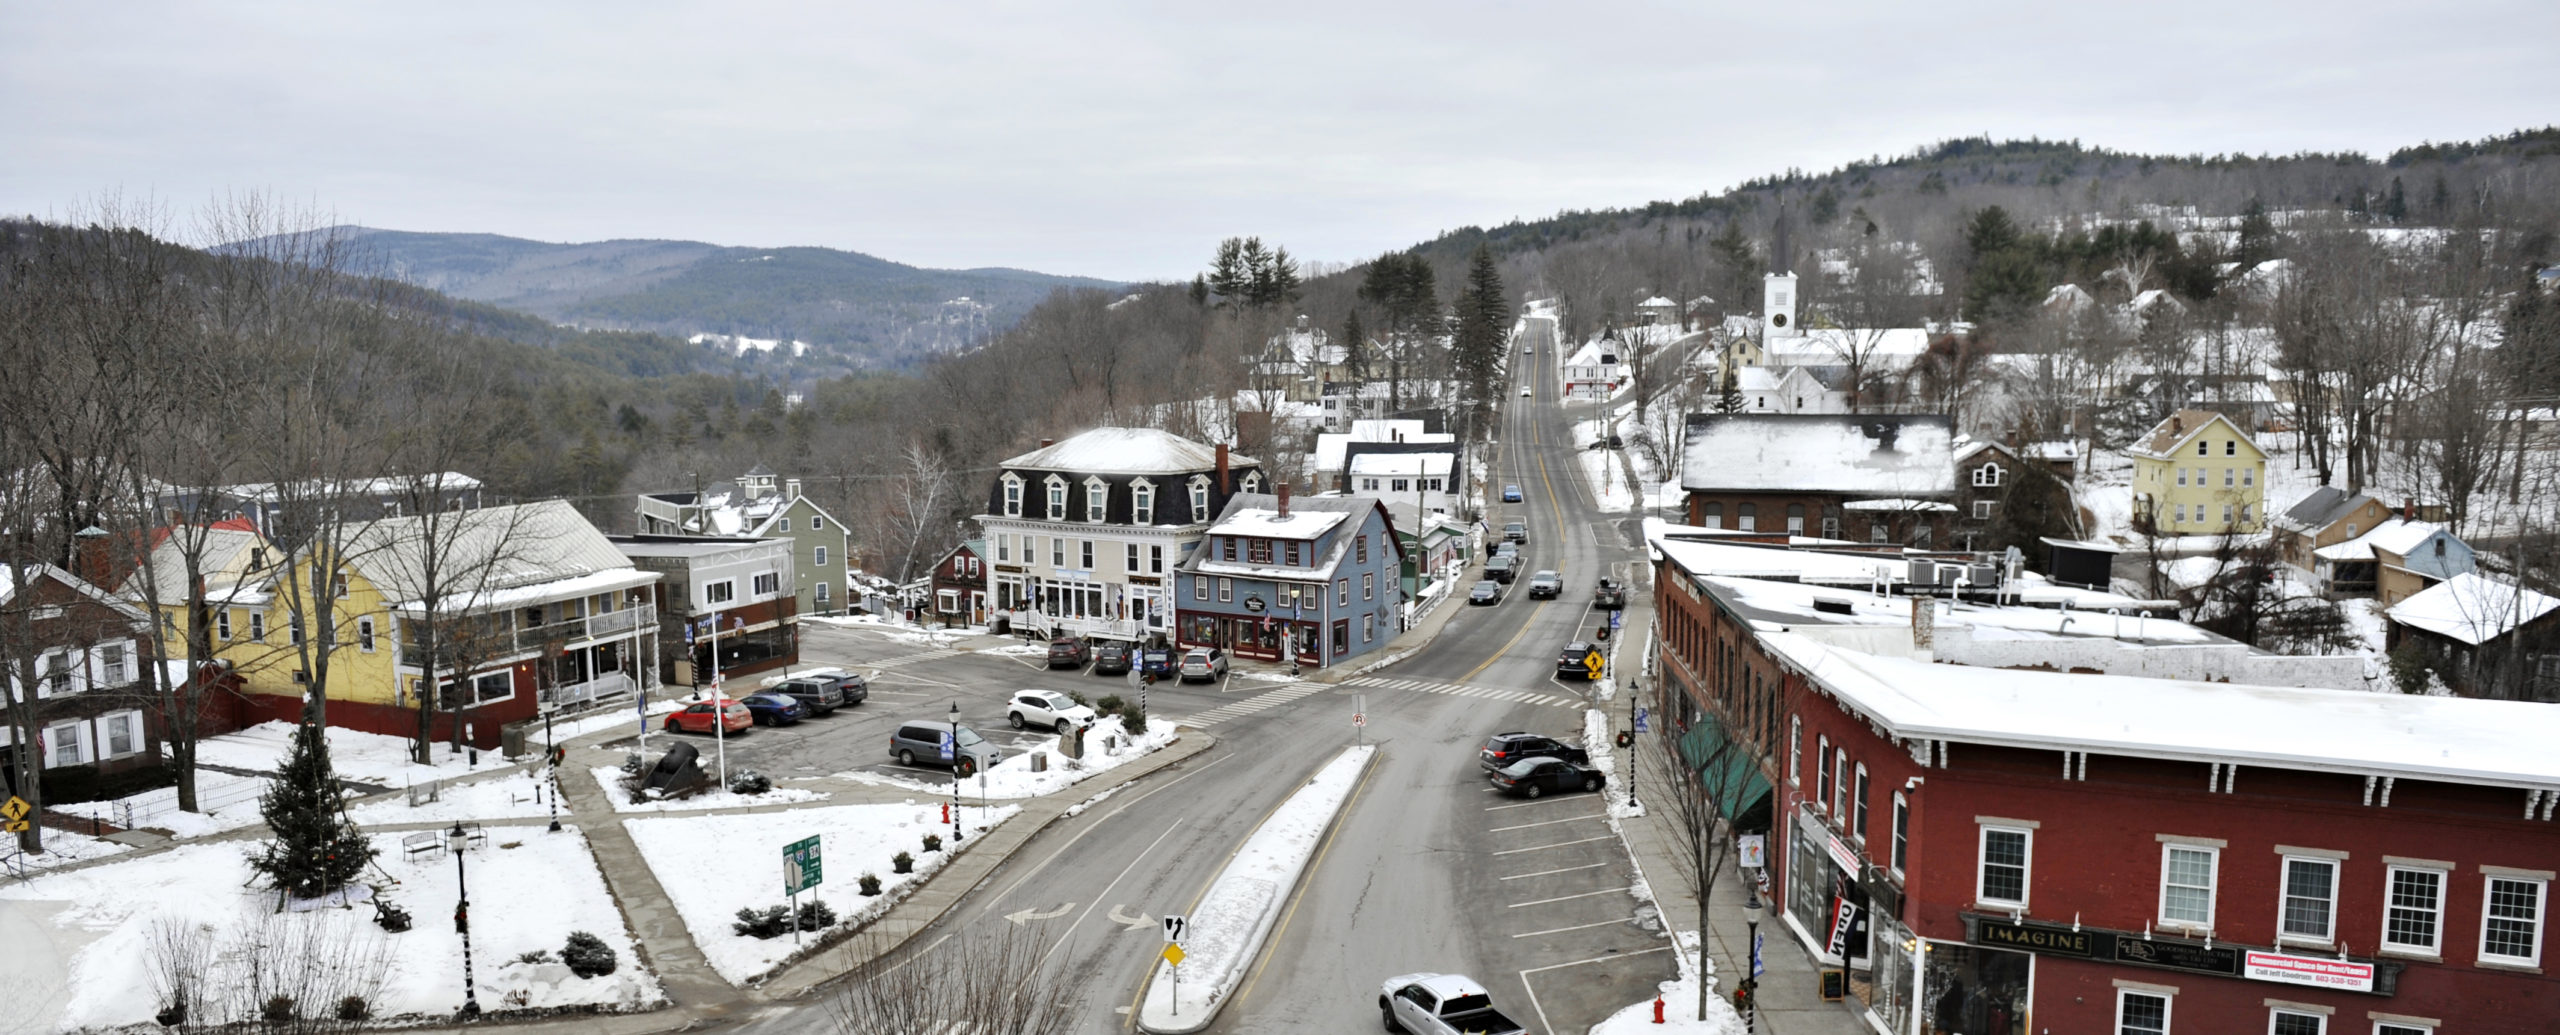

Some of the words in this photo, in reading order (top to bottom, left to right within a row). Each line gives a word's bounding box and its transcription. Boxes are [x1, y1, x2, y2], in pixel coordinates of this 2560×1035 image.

[1830, 904, 1852, 957] OPEN
[1986, 926, 2084, 950] IMAGINE
[2250, 955, 2293, 968] Commercial
[2294, 961, 2316, 971] Space
[2281, 971, 2312, 981] Goodrum
